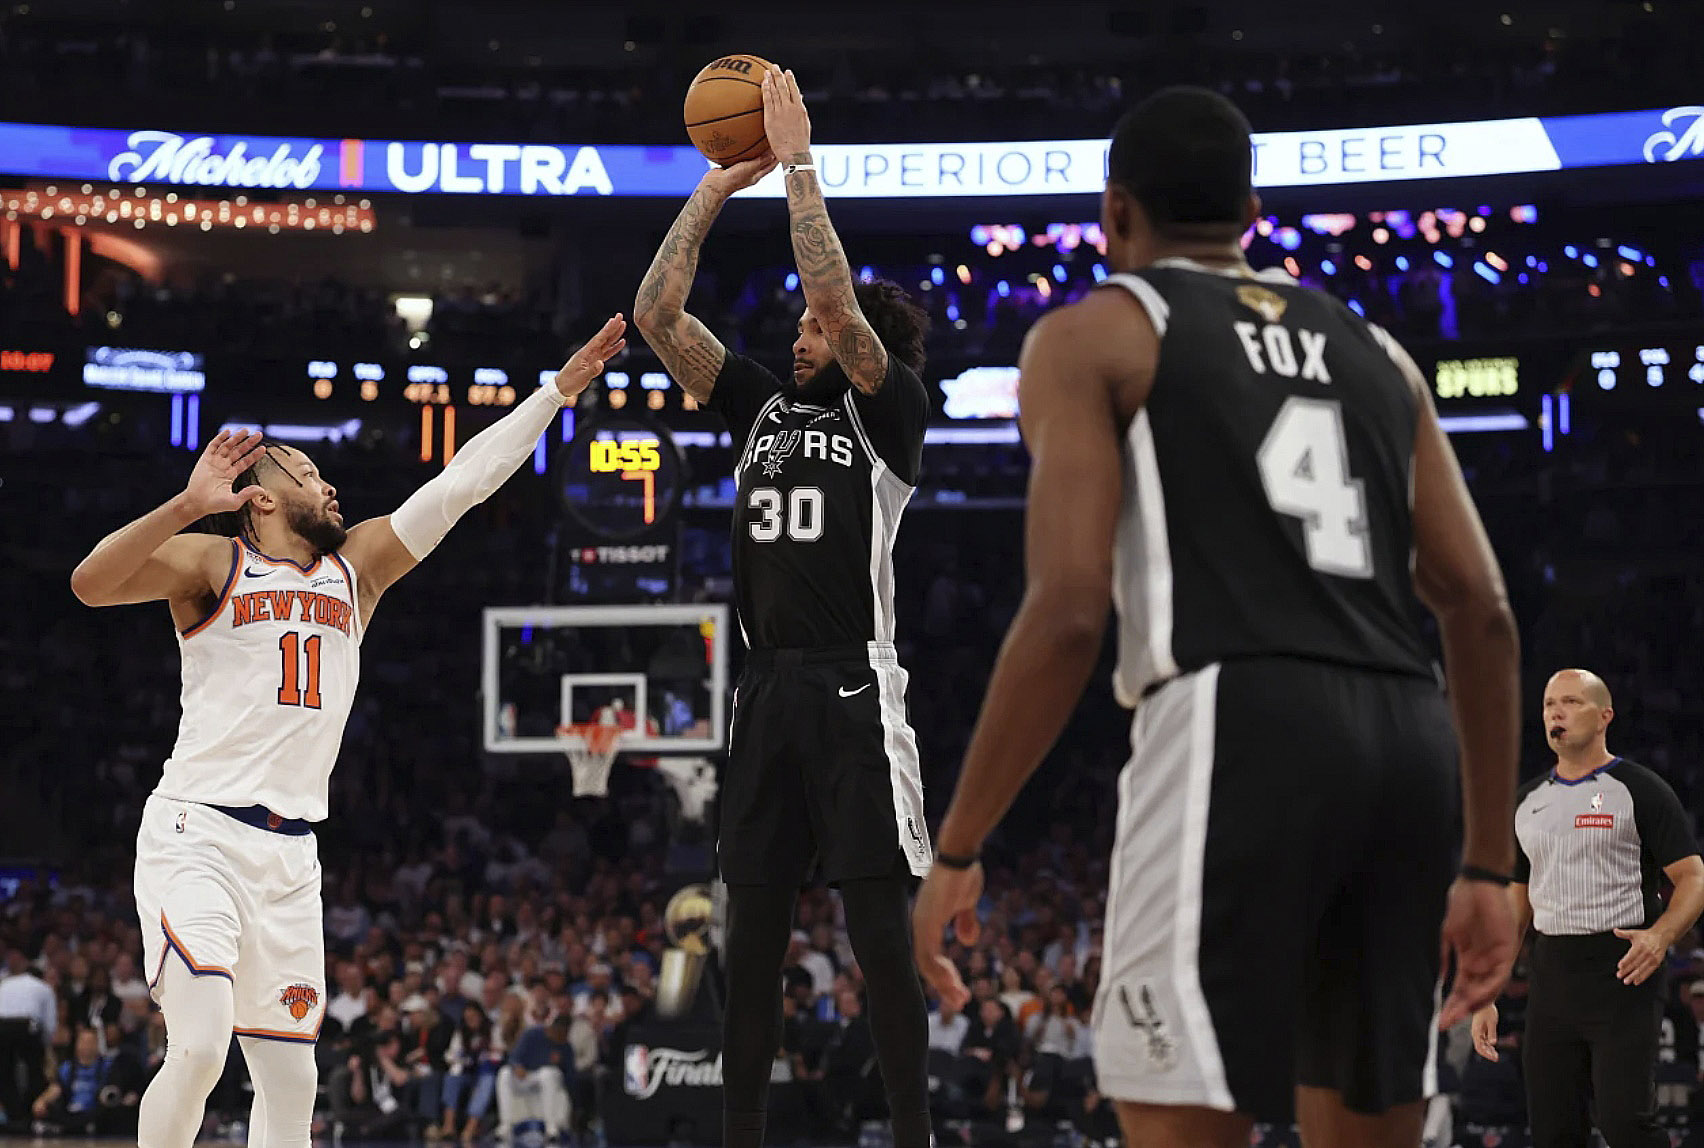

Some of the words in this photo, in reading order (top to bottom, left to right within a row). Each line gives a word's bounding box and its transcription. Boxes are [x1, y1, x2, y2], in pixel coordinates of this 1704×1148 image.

[108, 130, 324, 189] Michelob
[386, 142, 614, 195] ULTRA
[820, 149, 1072, 188] UPERIOR
[1299, 134, 1447, 175] BEER
[1233, 320, 1332, 385] FOX
[589, 439, 661, 473] 10:55
[620, 470, 655, 524] 7
[747, 486, 825, 543] 30
[1254, 395, 1375, 580] 4
[597, 545, 669, 564] TISSOT
[232, 590, 295, 629] NEW
[297, 590, 353, 639] YORK
[277, 631, 322, 710] 11
[1575, 815, 1613, 827] Emirates
[635, 1047, 724, 1100] Final
